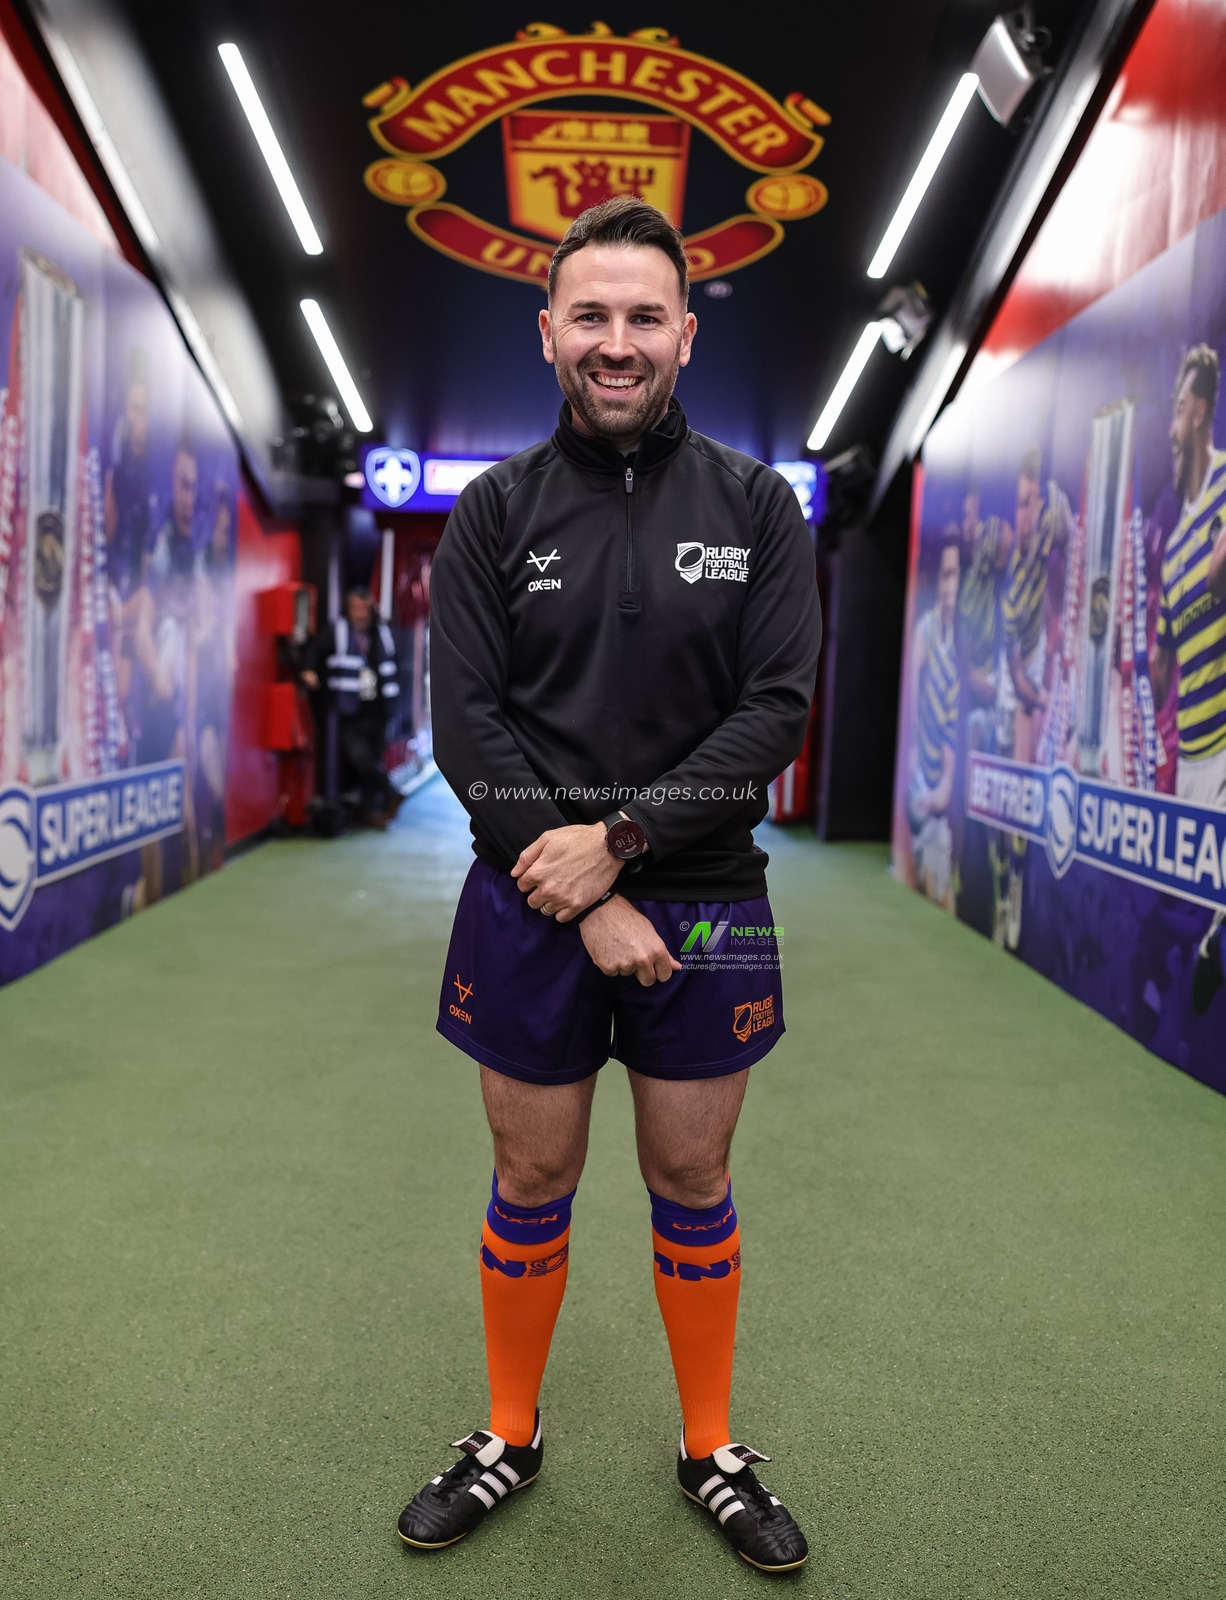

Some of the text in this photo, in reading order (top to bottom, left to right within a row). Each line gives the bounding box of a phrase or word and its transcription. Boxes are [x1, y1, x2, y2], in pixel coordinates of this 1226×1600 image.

[404, 50, 789, 157] MANCHESTER
[706, 546, 751, 562] RUGBY
[704, 567, 749, 583] LEAGUE
[705, 559, 749, 571] FOOTBALL
[527, 578, 562, 593] OXEN
[41, 772, 181, 866] SUPER LEAGUE
[1080, 793, 1155, 868] SUPER
[449, 1004, 472, 1025] OXEN
[494, 1205, 558, 1225] OXEN
[672, 1207, 733, 1232] OXEN
